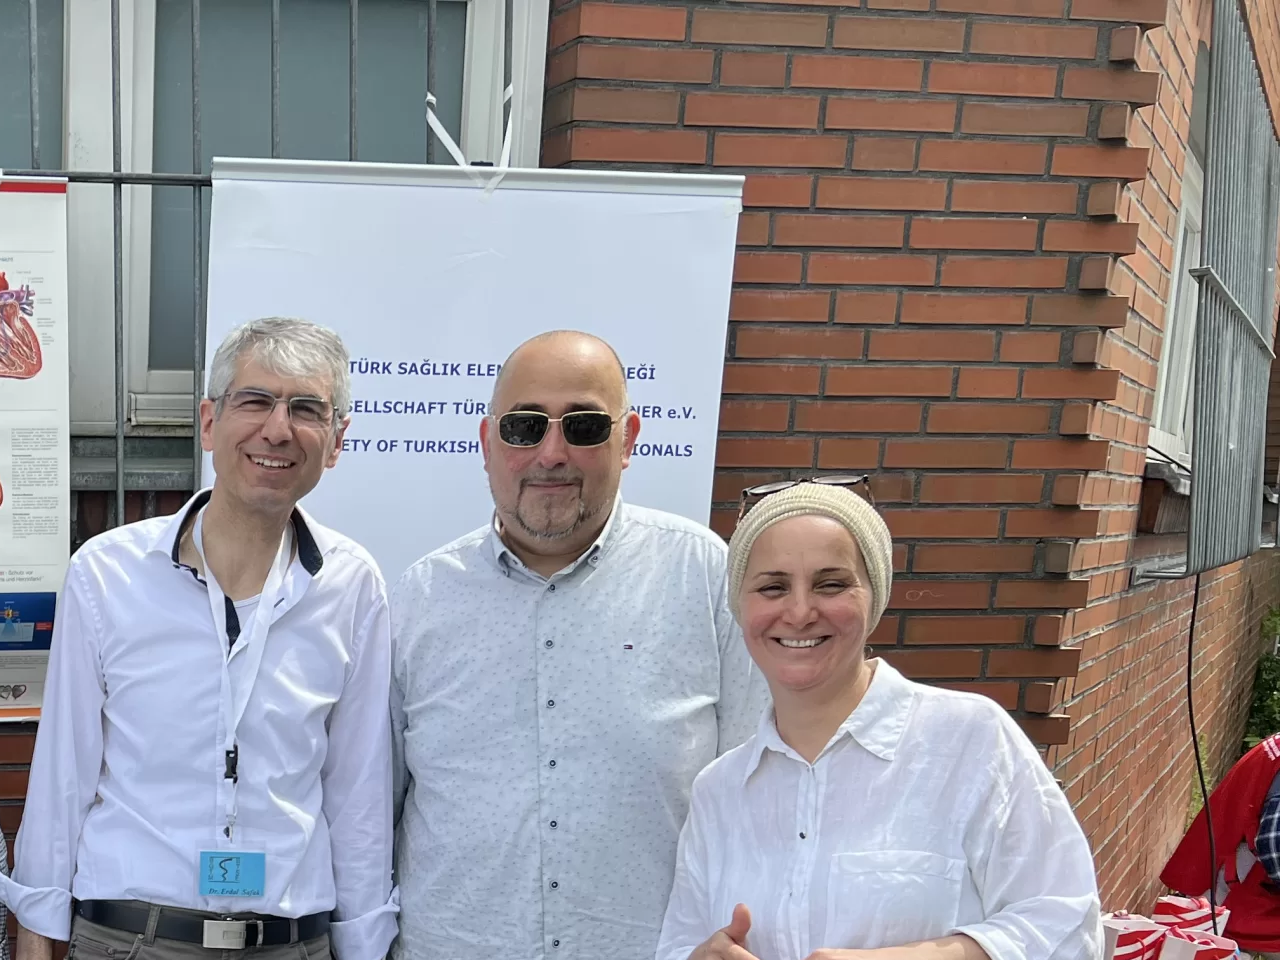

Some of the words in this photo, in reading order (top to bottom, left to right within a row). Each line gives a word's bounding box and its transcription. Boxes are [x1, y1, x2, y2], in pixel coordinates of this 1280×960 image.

[349, 358, 393, 374] TÜRK
[397, 359, 461, 377] SAĞLIK
[625, 363, 656, 380] EĞİ
[453, 399, 490, 415] TÜR
[667, 406, 696, 420] e.V.
[376, 439, 398, 453] OF
[404, 440, 480, 454] TURKISH
[631, 443, 693, 457] IONALS
